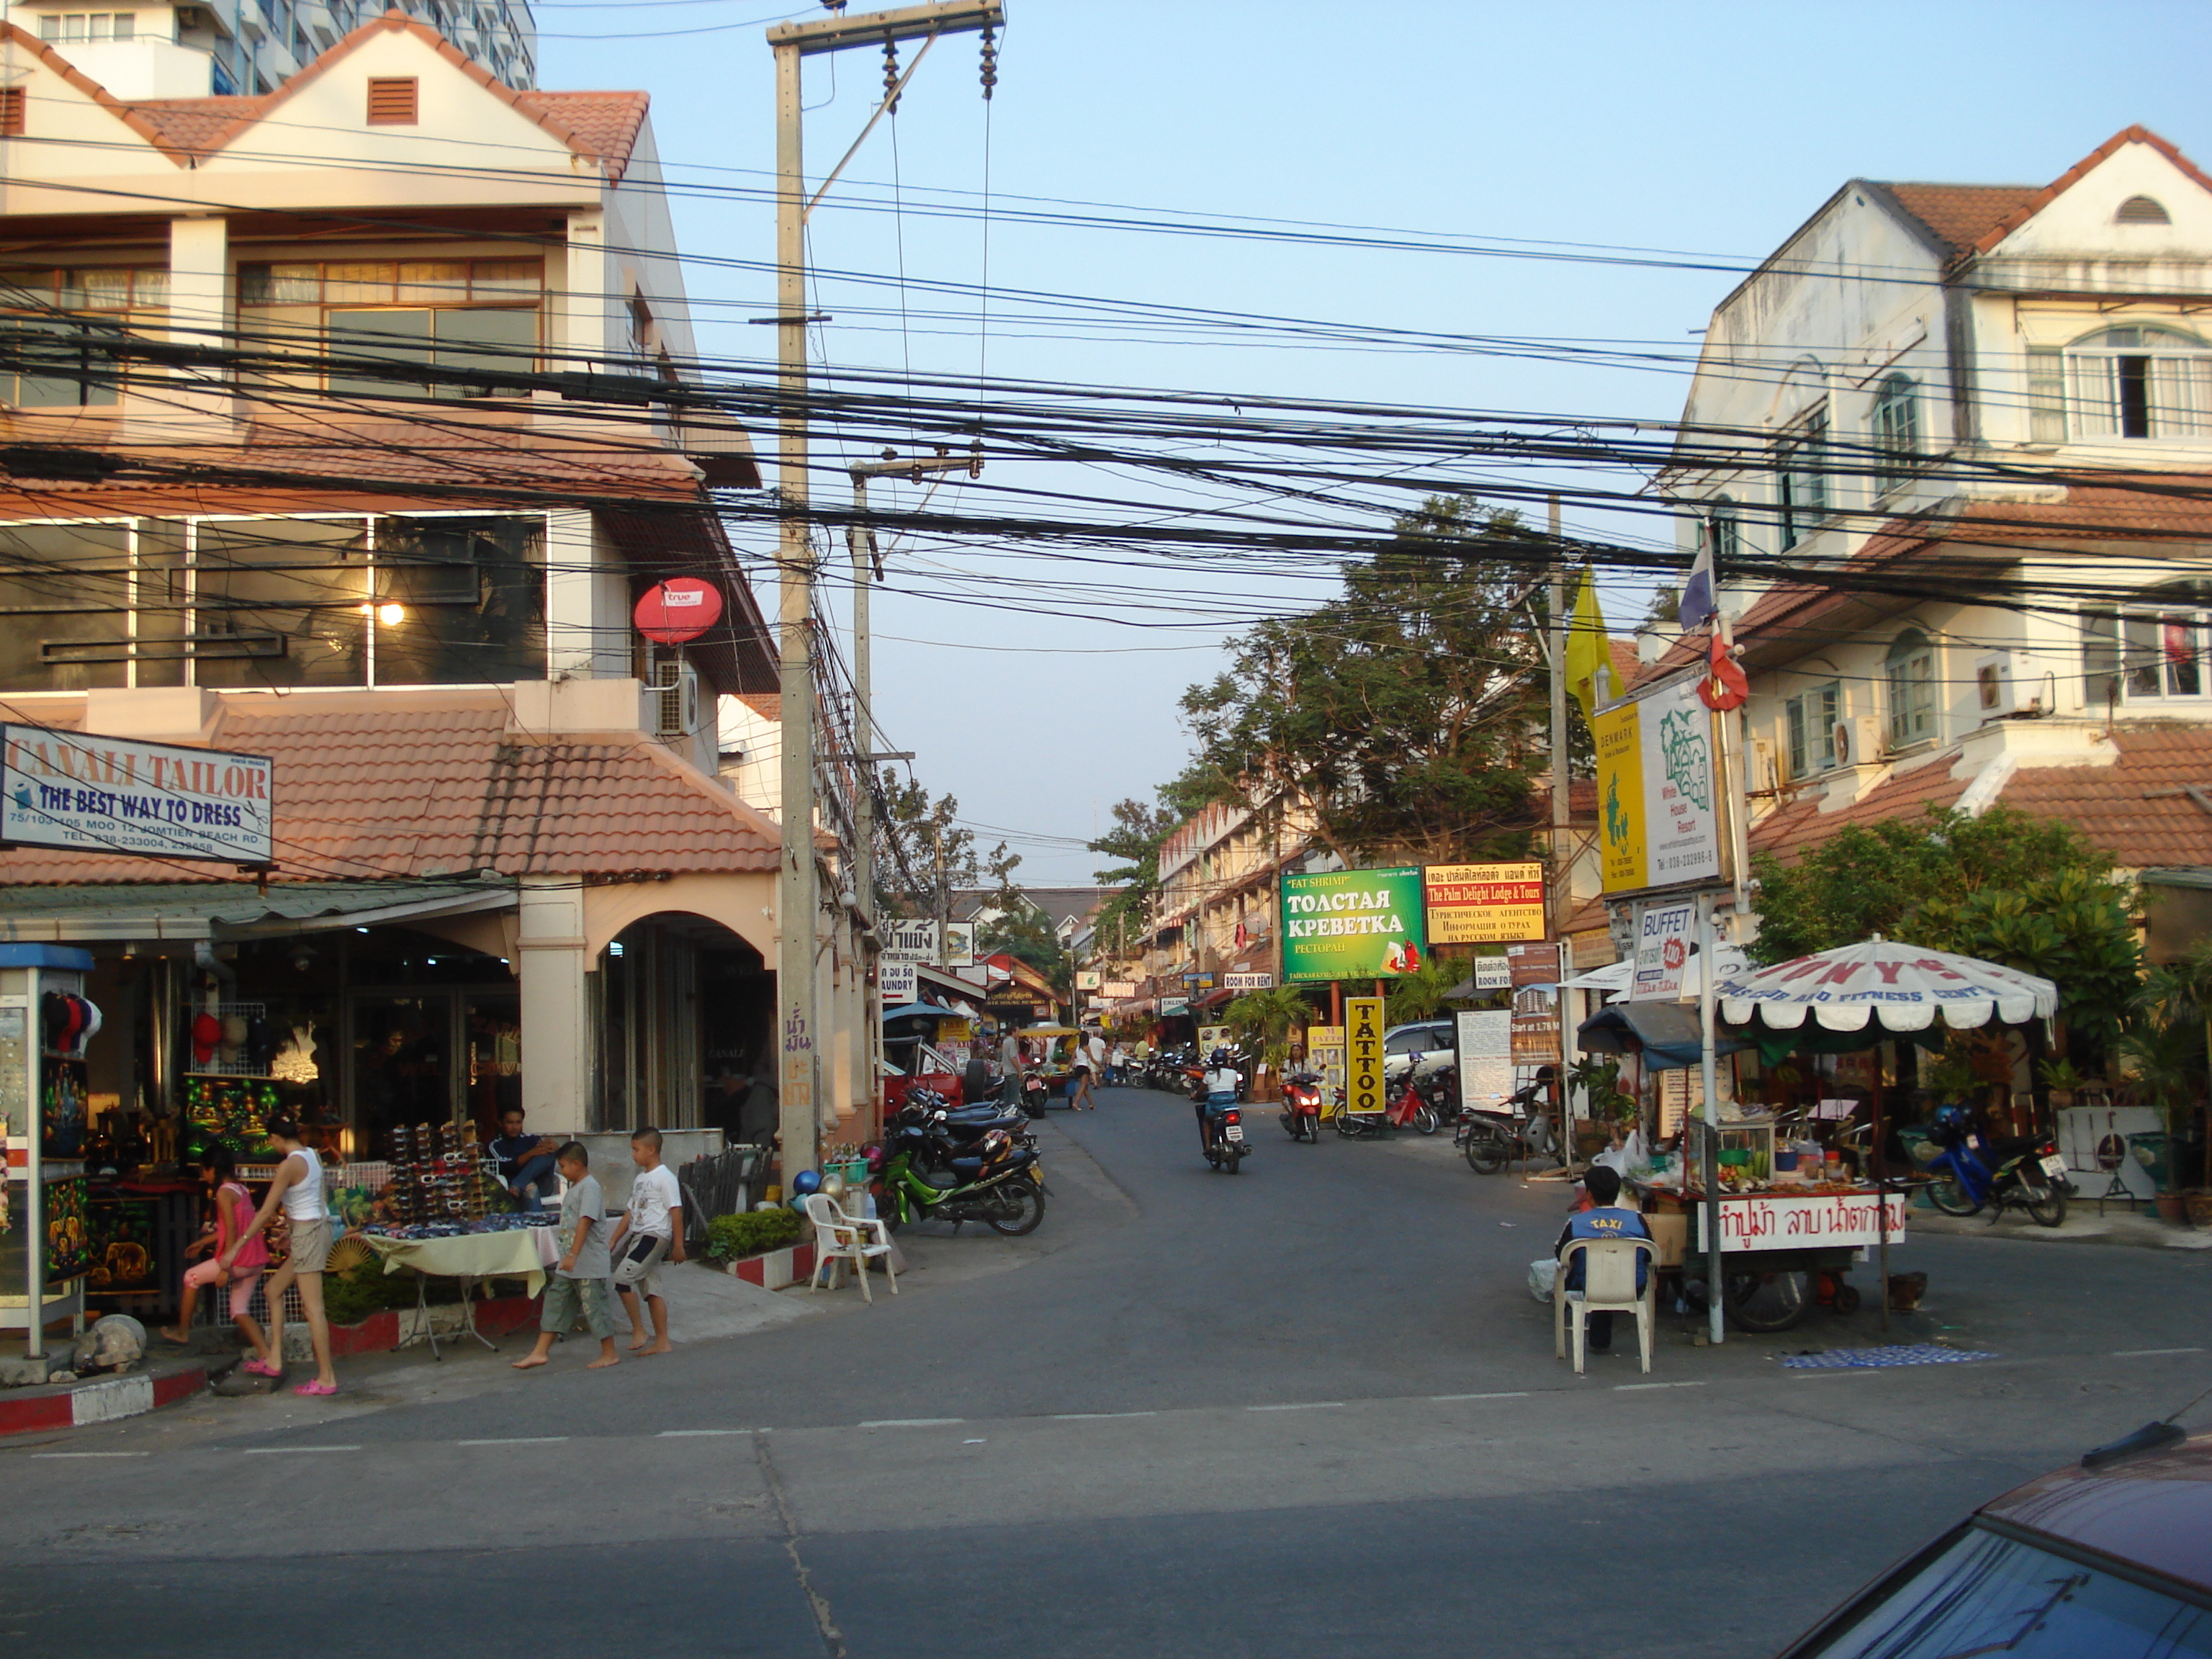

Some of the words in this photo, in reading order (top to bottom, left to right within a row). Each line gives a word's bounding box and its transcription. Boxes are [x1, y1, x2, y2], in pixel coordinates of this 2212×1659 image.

[1601, 727, 1632, 748] DENMARK
[8, 739, 137, 787] CANALI
[148, 753, 268, 800] TAILOR
[1662, 786, 1676, 800] White
[40, 786, 71, 811] THE
[76, 788, 116, 816] BEST
[121, 794, 161, 819] WAY
[166, 799, 186, 822] TO
[192, 801, 240, 827] DRESS
[1671, 804, 1687, 817] House
[10, 812, 81, 828] 75/103-105
[86, 819, 115, 830] MOO
[122, 824, 135, 832] 12
[140, 826, 193, 837] JOMTIEN
[199, 830, 238, 842] BEACH
[243, 835, 262, 845] RD.
[1677, 818, 1696, 834] Resort
[63, 831, 89, 842] TEL.
[1505, 866, 1525, 880] แอนด์
[1528, 865, 1540, 879] ทัวร์
[1429, 888, 1442, 902] The
[1444, 886, 1461, 902] Palm
[1462, 886, 1489, 904] Delight
[1491, 885, 1512, 903] Lodge
[1513, 886, 1519, 899] &
[1519, 885, 1539, 899] Tours
[1287, 890, 1390, 914] ТОЛСТАЯ
[1500, 908, 1542, 917] АГЕНТСТВО
[1288, 914, 1404, 938] КРЕВЕТКА
[1644, 909, 1690, 936] BUFFET
[1461, 933, 1496, 942] РУССКОМ
[1295, 943, 1346, 955] РЕСТОРАН
[881, 980, 913, 991] AUNDRY
[1226, 976, 1243, 986] ROOM
[1245, 976, 1255, 986] FOR
[1257, 975, 1271, 986] RENT
[1478, 976, 1497, 986] ROOM
[1793, 991, 1832, 1002] AND
[1839, 990, 1924, 1002] FITNESS
[1511, 1022, 1527, 1033] Start
[1536, 1022, 1552, 1031] 1.78
[1355, 1004, 1376, 1109] TATTOO
[1590, 1218, 1623, 1230] TAXI
[1784, 1208, 1821, 1235] ลาบ
